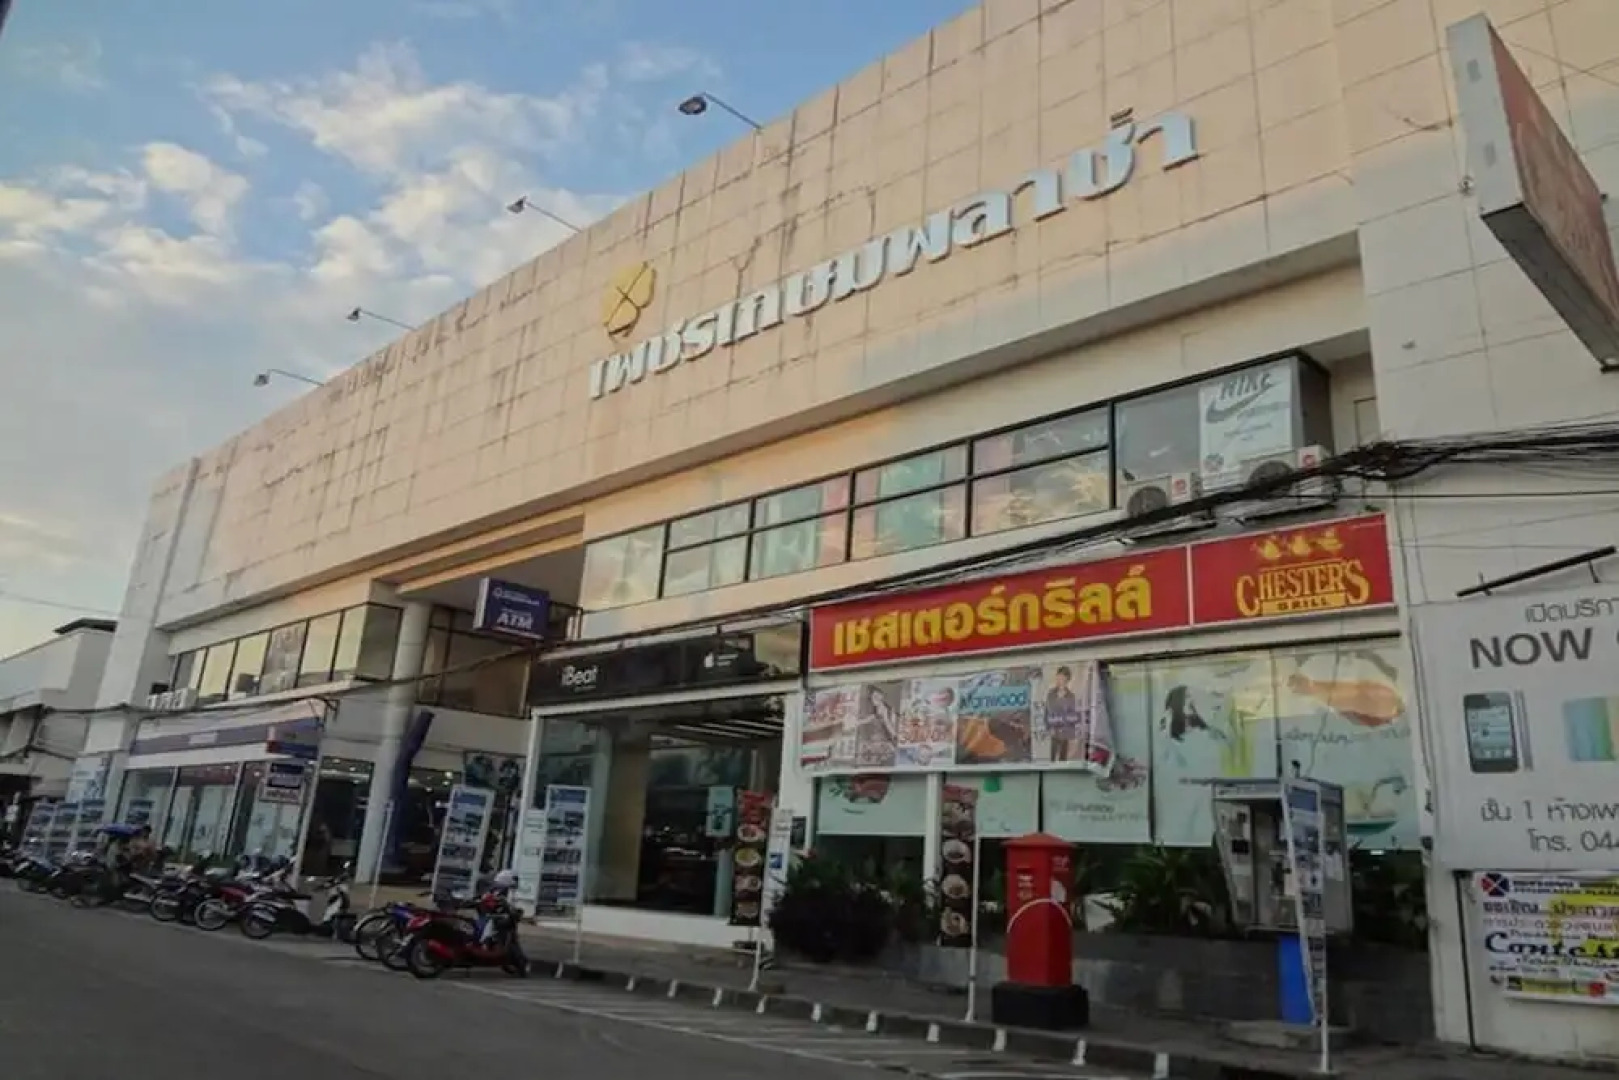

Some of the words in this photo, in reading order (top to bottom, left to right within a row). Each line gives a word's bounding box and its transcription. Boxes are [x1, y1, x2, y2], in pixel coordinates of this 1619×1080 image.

[589, 107, 1200, 400] เพชรเกษมพลาซ่า
[497, 613, 534, 630] ATM
[833, 565, 1152, 655] เชสเตอร์กริลล์
[1470, 627, 1593, 668] NOW
[1481, 797, 1512, 822] ชั้น
[1524, 799, 1534, 820] 1
[1547, 797, 1619, 820] ห้างเพ
[1527, 828, 1572, 852] โทร.
